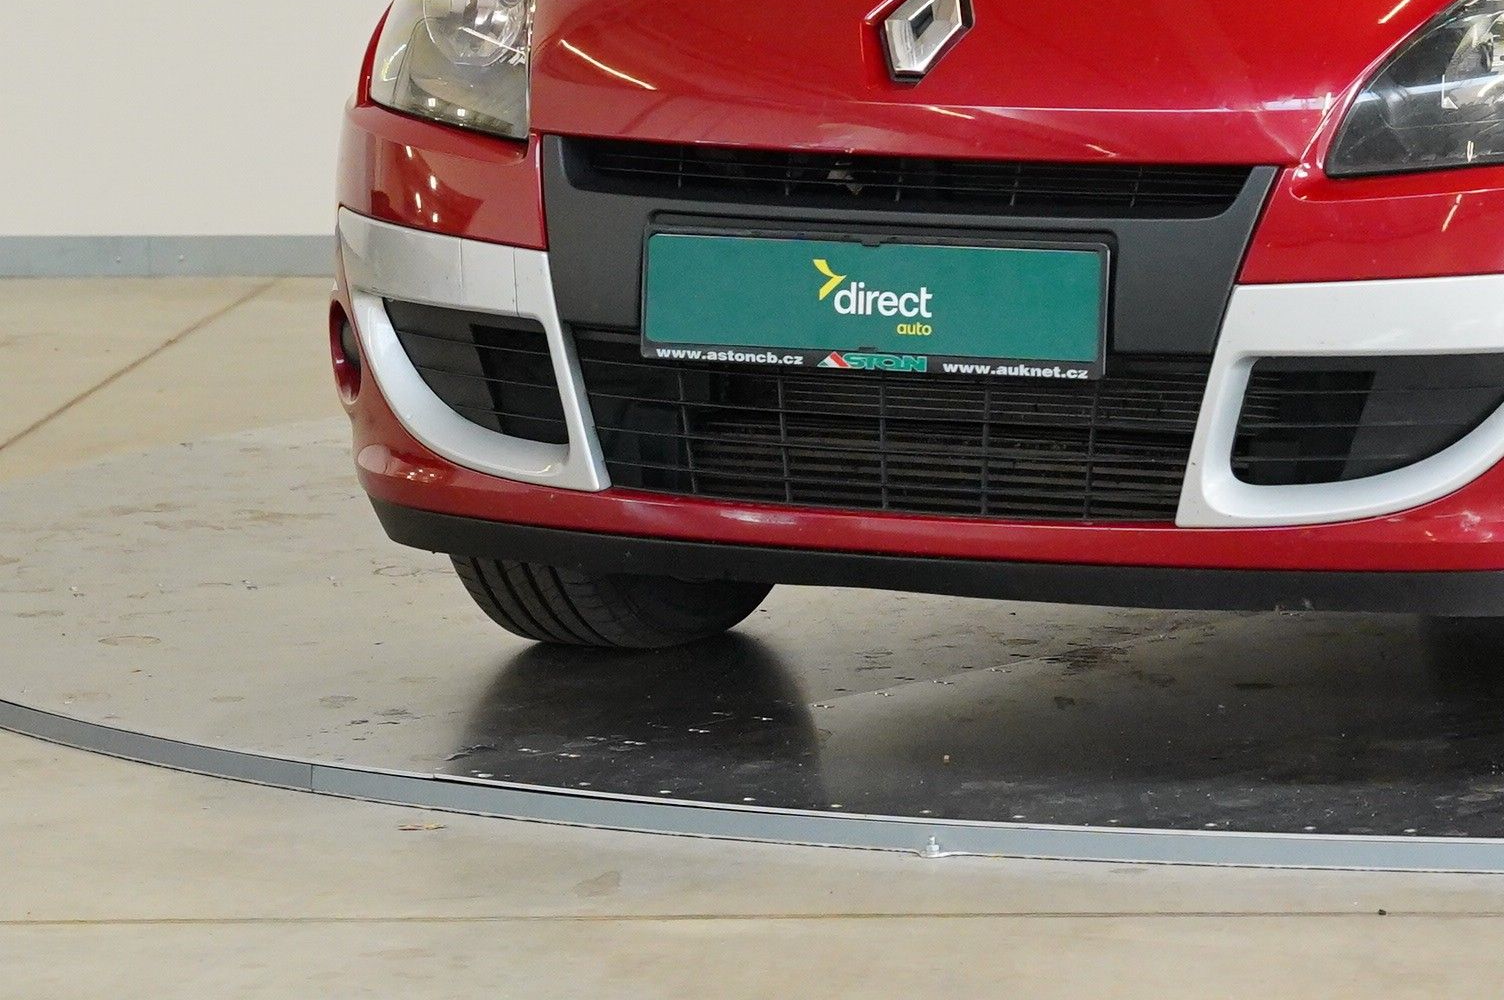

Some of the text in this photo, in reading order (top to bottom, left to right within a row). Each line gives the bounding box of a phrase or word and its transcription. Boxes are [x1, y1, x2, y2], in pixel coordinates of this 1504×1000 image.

[834, 281, 933, 318] direct
[896, 321, 932, 336] auto
[656, 347, 804, 366] www.astoncb.cz
[943, 362, 1089, 380] www.auknet.cz
